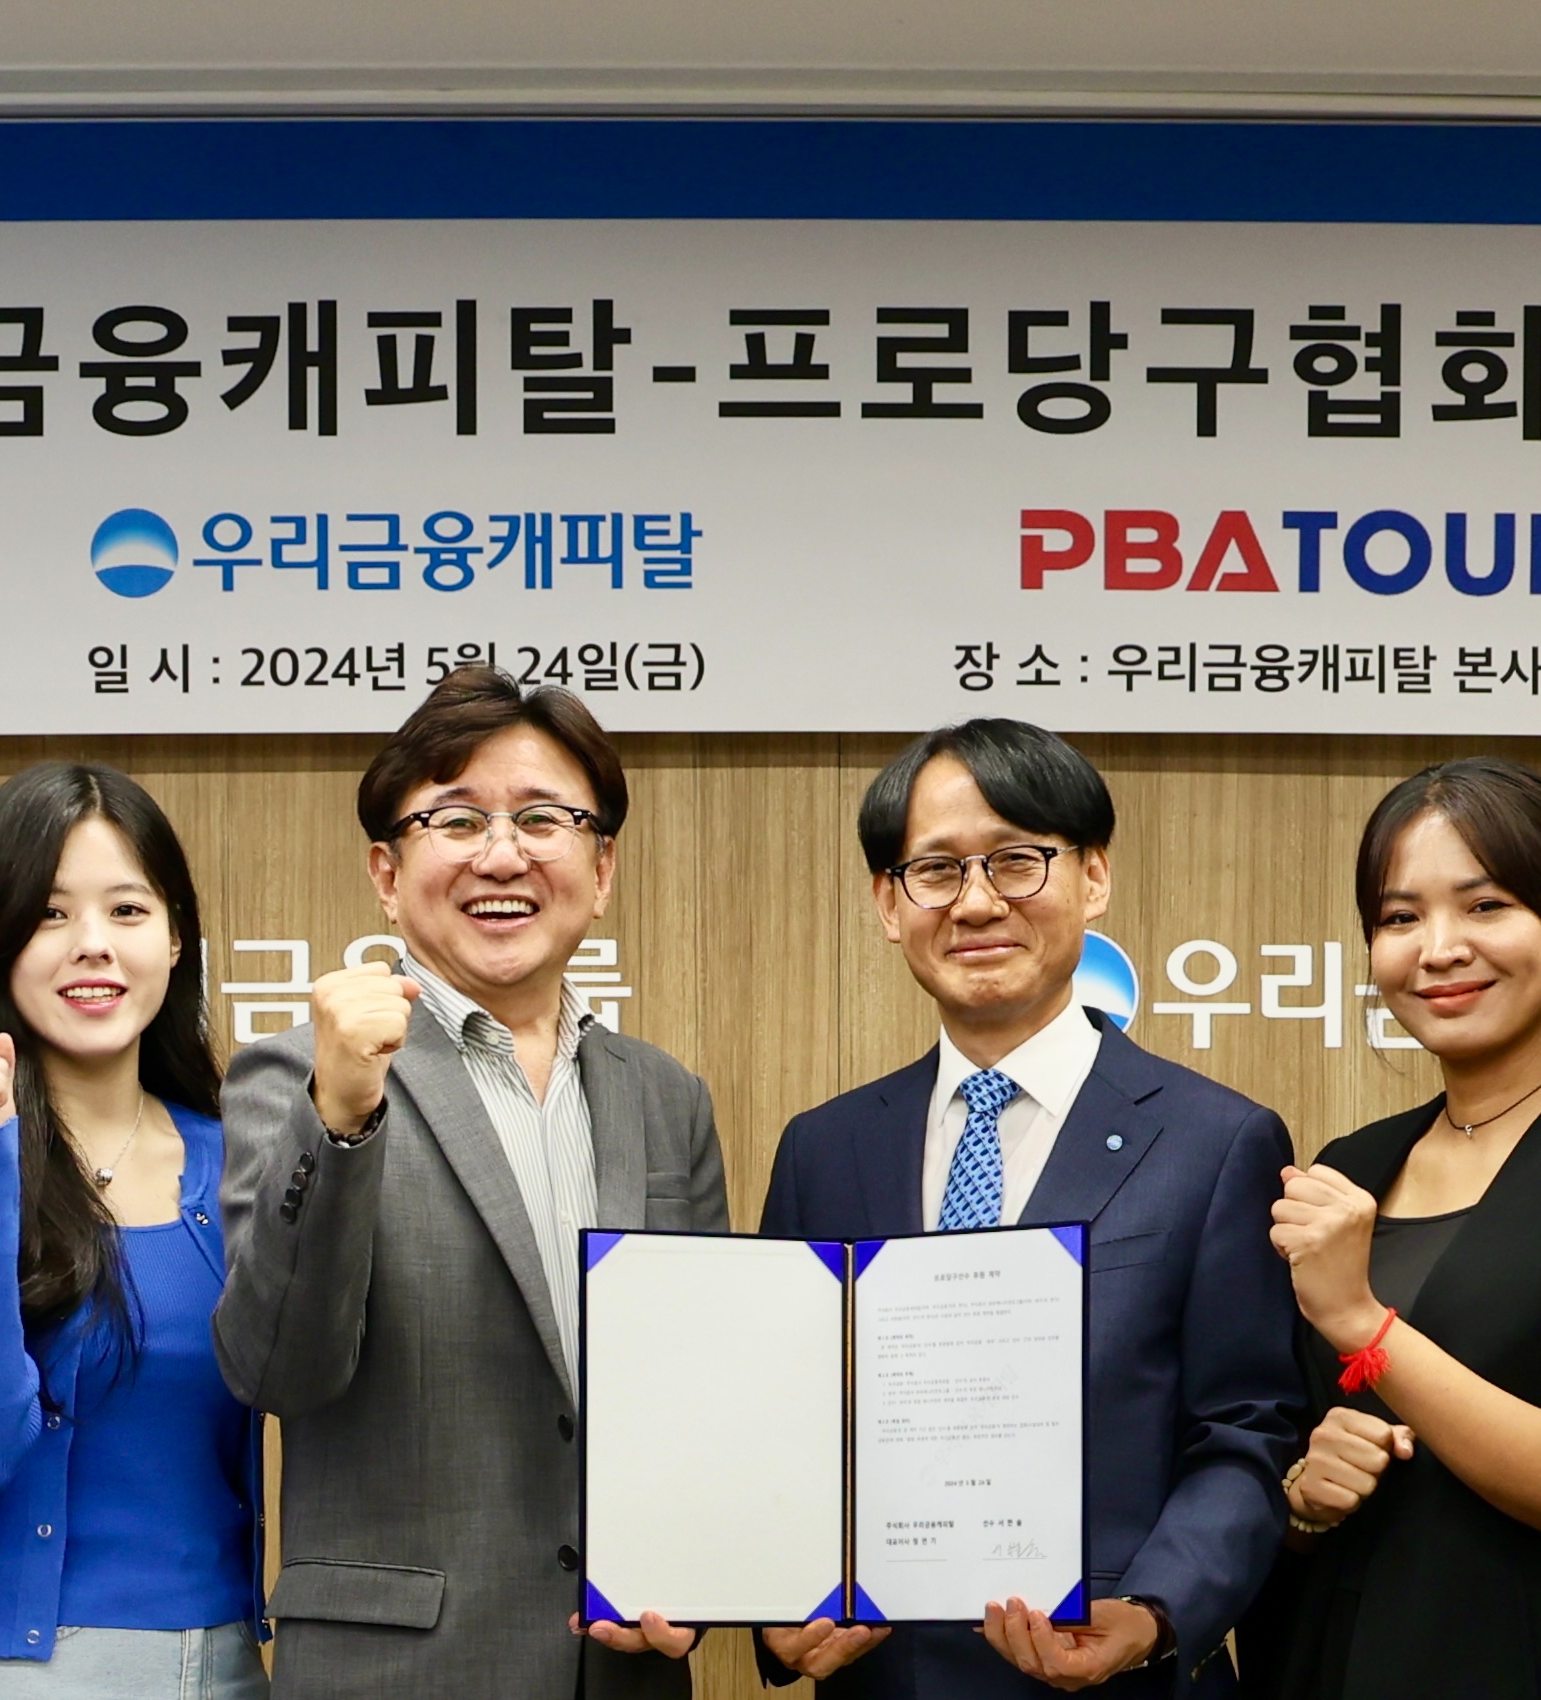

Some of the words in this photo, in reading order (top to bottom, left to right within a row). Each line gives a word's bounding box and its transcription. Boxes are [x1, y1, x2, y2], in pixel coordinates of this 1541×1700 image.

[192, 510, 703, 593] 우리금융캐피탈
[88, 644, 129, 694] 일
[149, 644, 189, 693] 시
[240, 642, 406, 691] 2024년
[516, 642, 705, 693] 24일(금)
[954, 642, 1000, 691] 장
[1016, 644, 1061, 686] 소
[1107, 643, 1437, 694] 우리금융캐피탈
